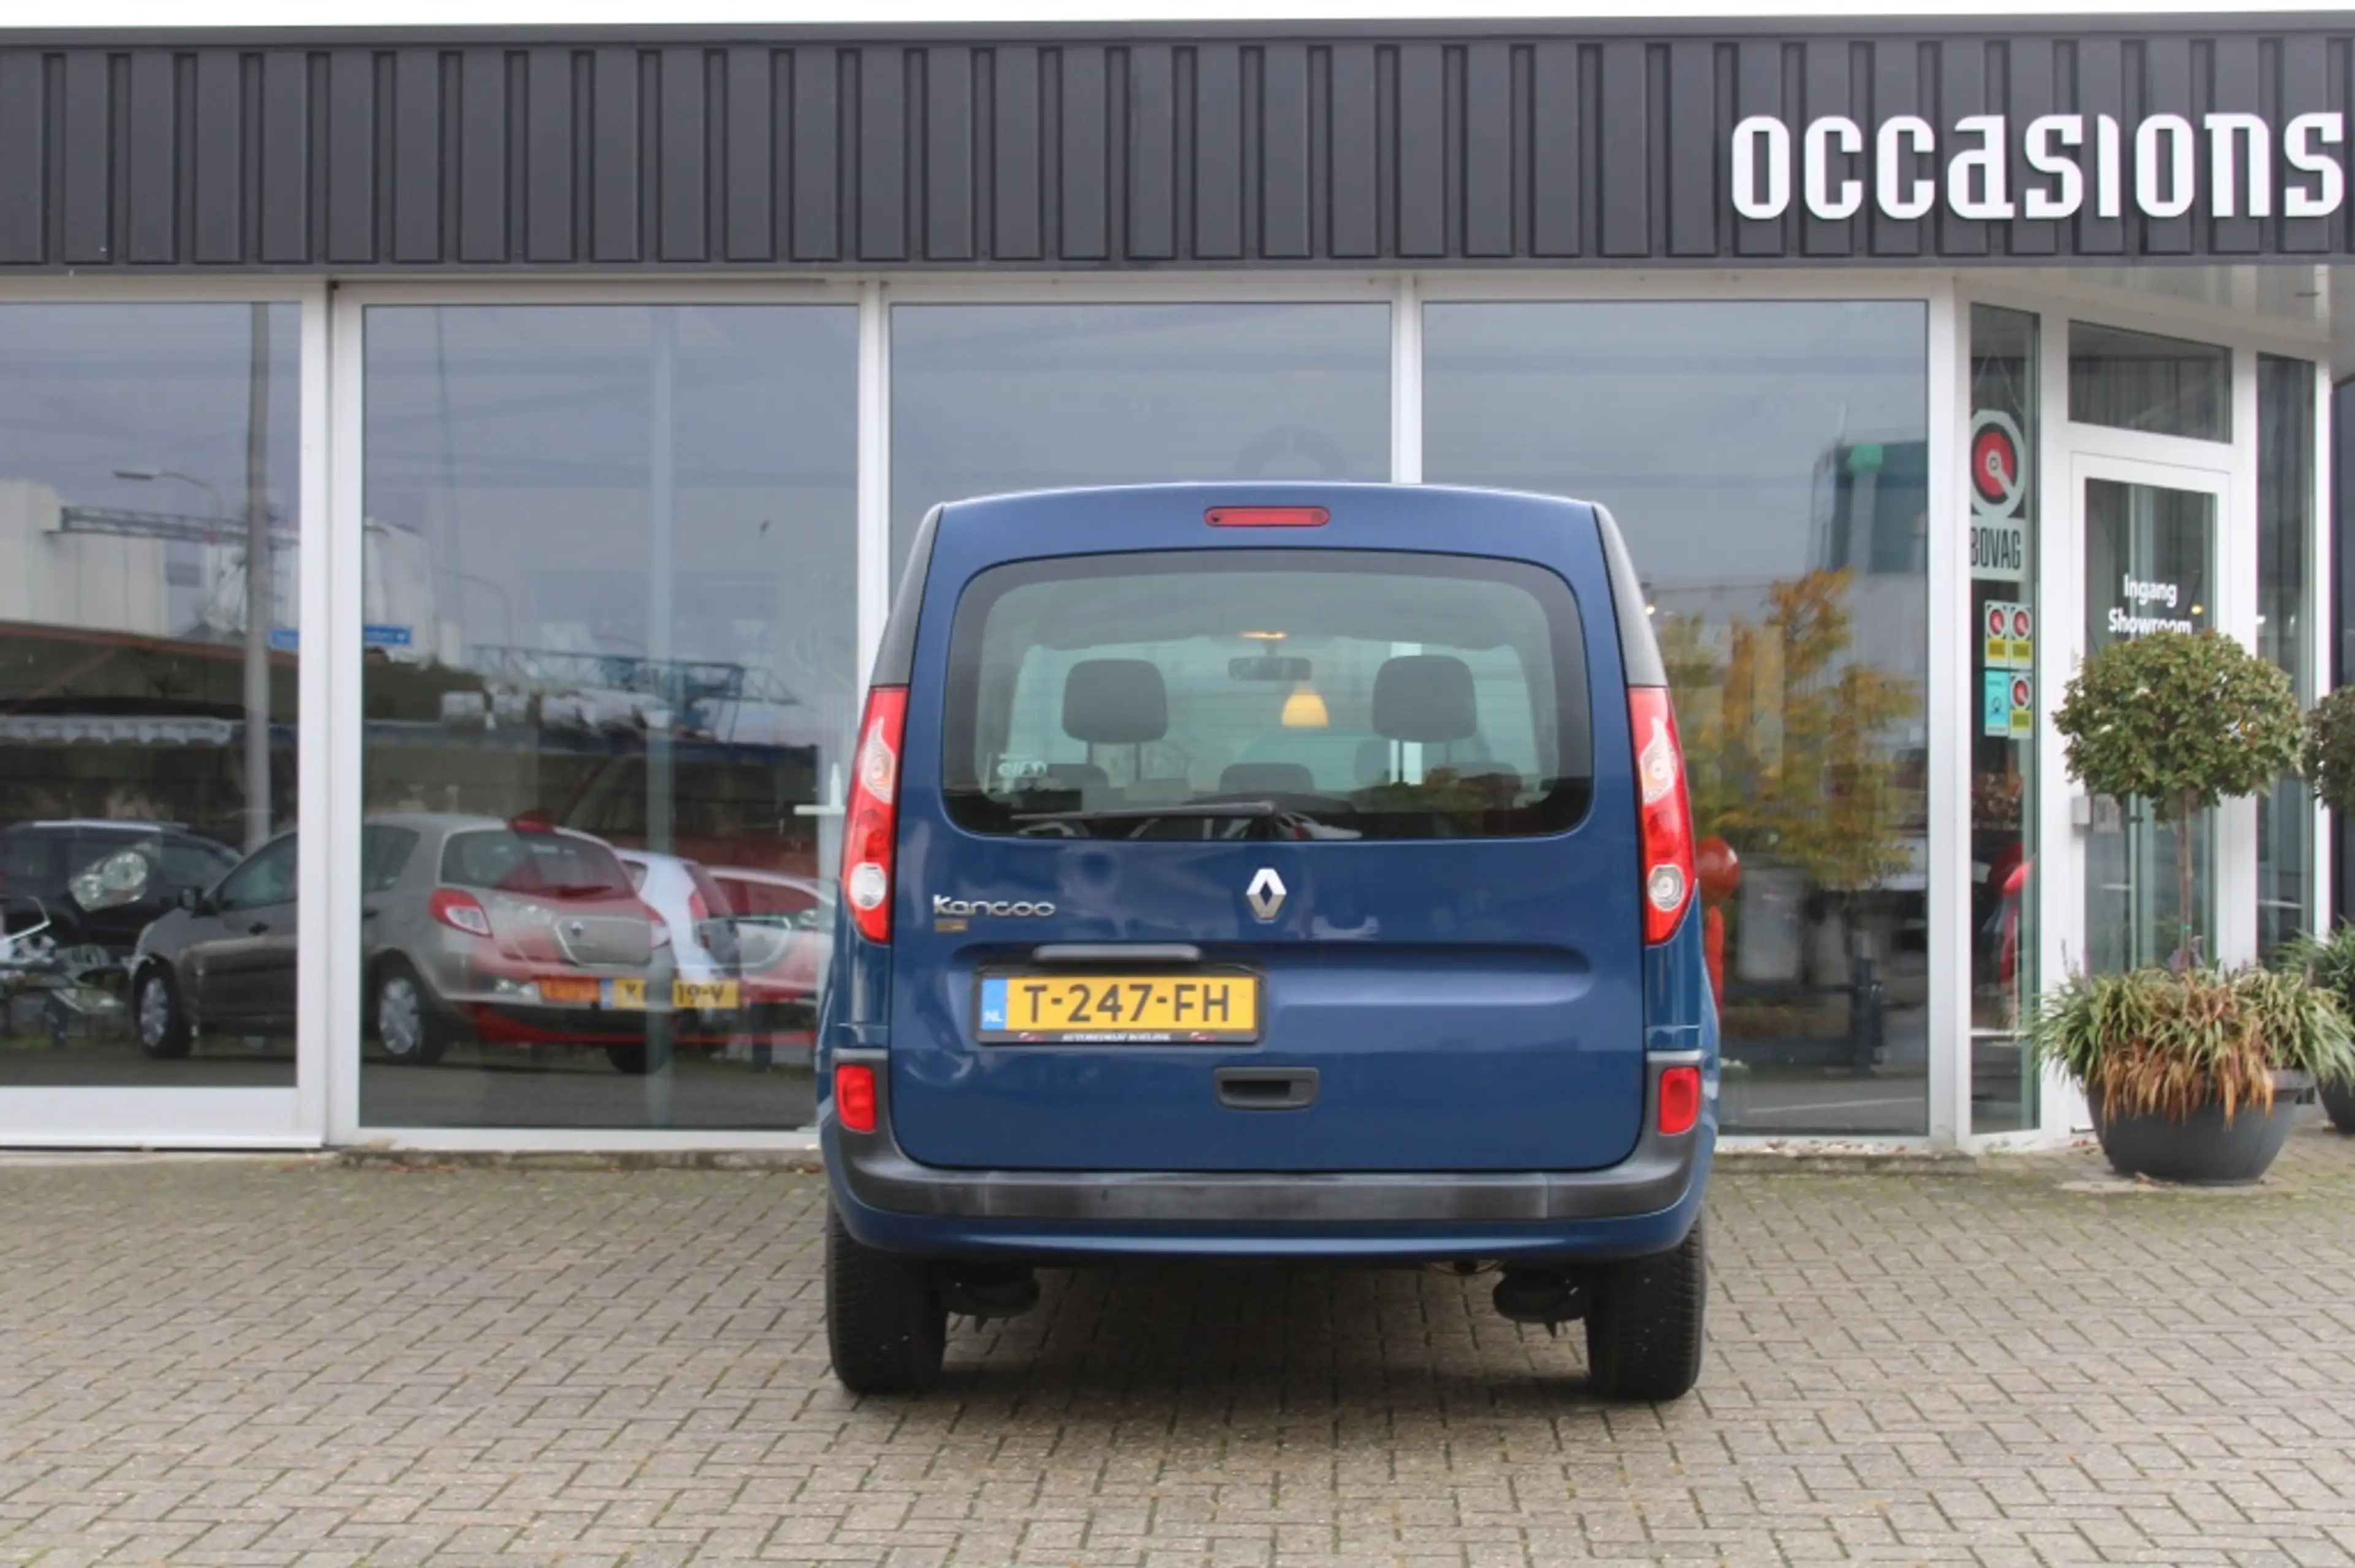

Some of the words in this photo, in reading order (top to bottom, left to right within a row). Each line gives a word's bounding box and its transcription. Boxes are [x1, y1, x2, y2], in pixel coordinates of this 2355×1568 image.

[1970, 526, 2021, 570] BOVAG
[2123, 573, 2177, 607] Ingang
[2108, 608, 2192, 634] Showroom
[984, 1010, 1004, 1023] NL
[1023, 984, 1230, 1023] T-247-FH
